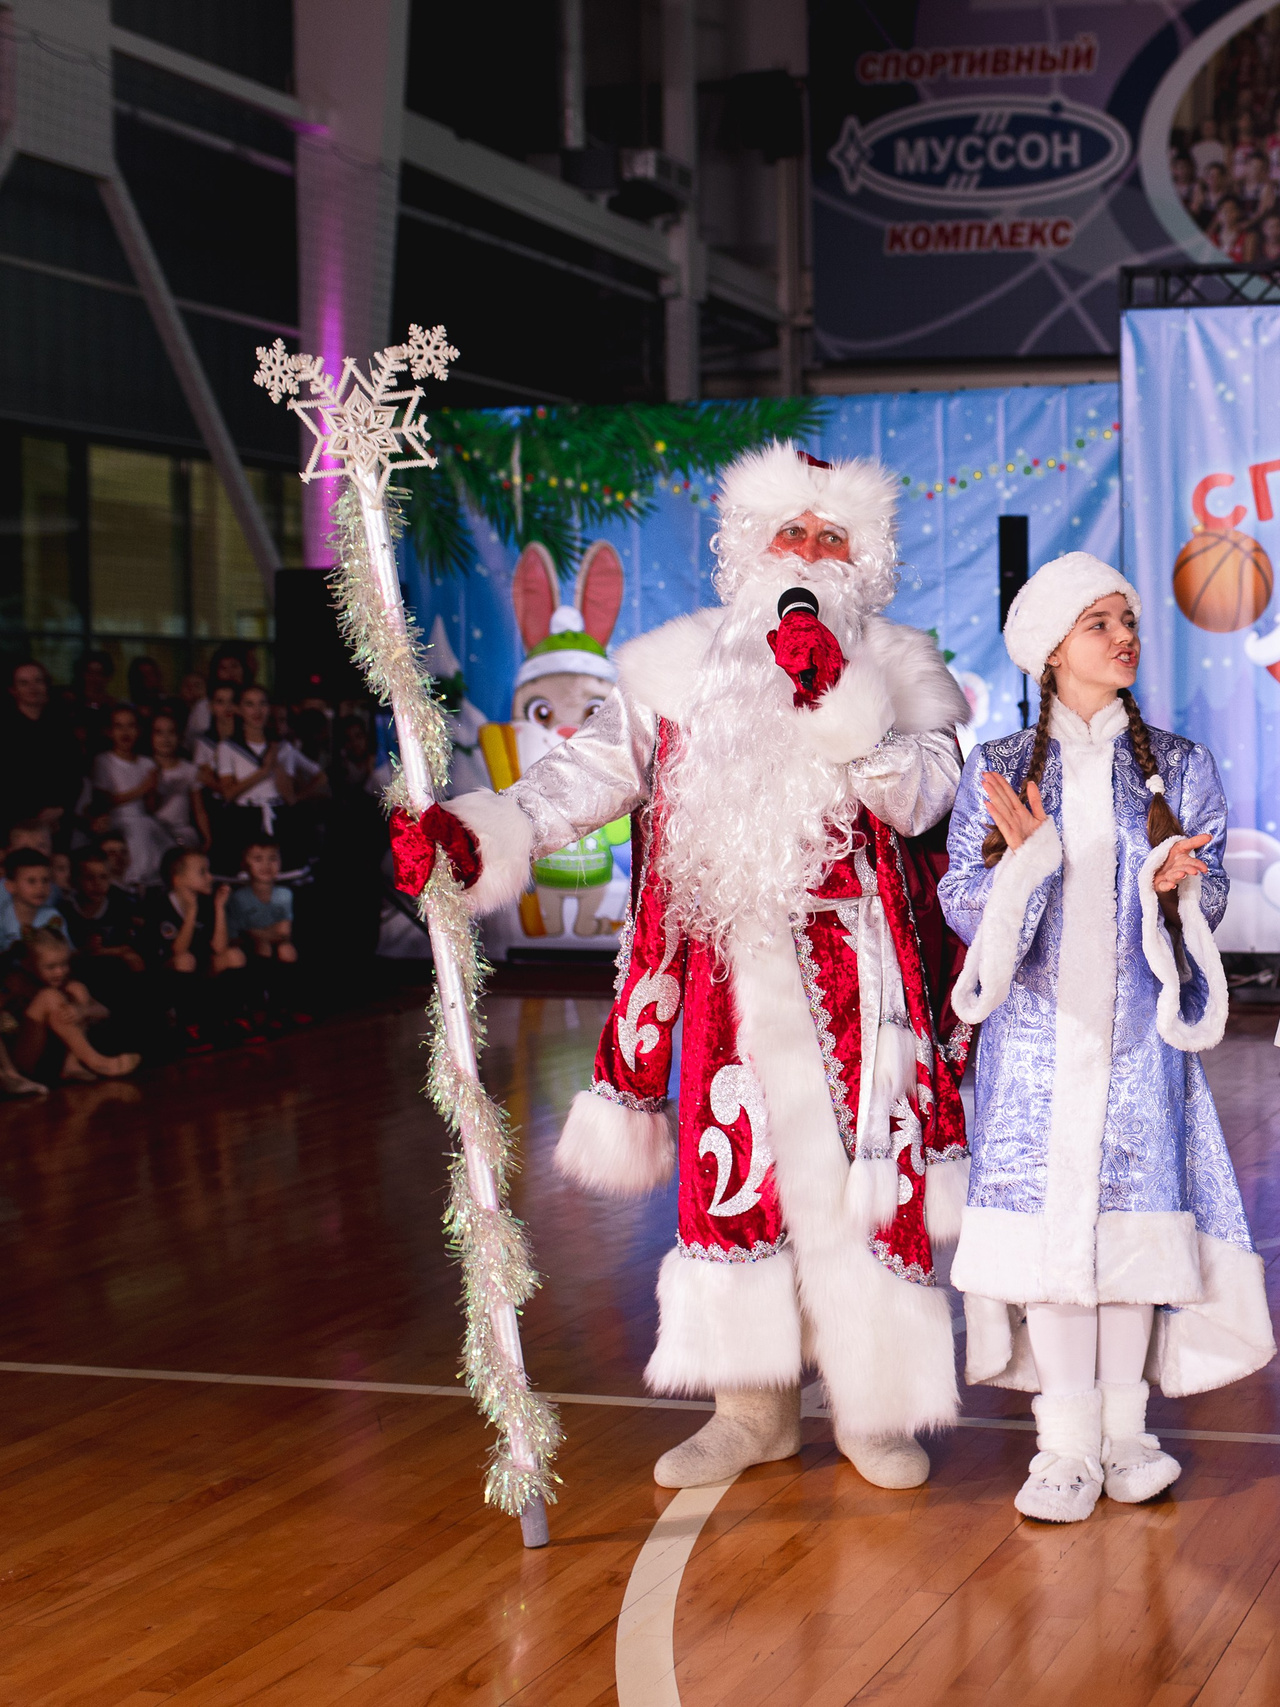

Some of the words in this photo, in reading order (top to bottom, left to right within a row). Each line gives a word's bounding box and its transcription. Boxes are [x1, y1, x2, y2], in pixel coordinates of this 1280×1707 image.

[858, 34, 1096, 82] СПОРТИВНЫЙ
[893, 130, 1081, 174] МУССОН
[886, 218, 1074, 252] КОМПЛЕКС
